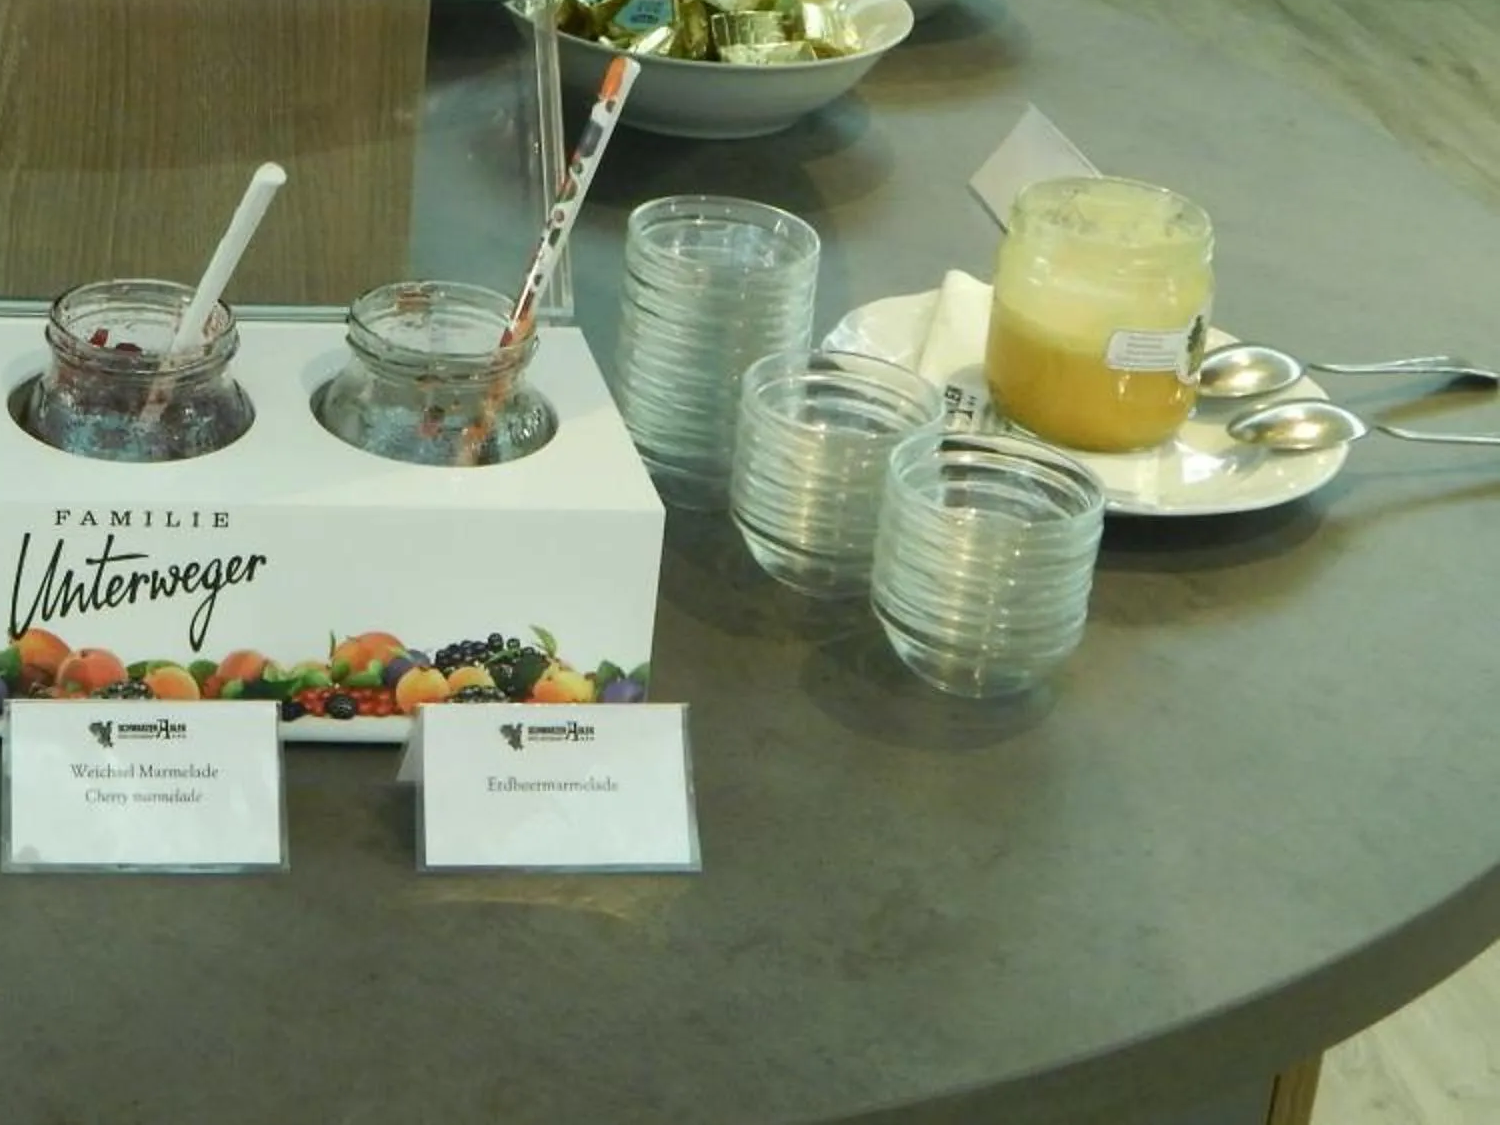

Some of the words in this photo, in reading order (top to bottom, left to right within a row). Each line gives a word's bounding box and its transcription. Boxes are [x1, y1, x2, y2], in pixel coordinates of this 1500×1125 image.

[54, 510, 230, 528] FAMILIE
[8, 532, 267, 652] Unterweger
[139, 763, 219, 779] Marmelade
[85, 788, 128, 805] Cherry
